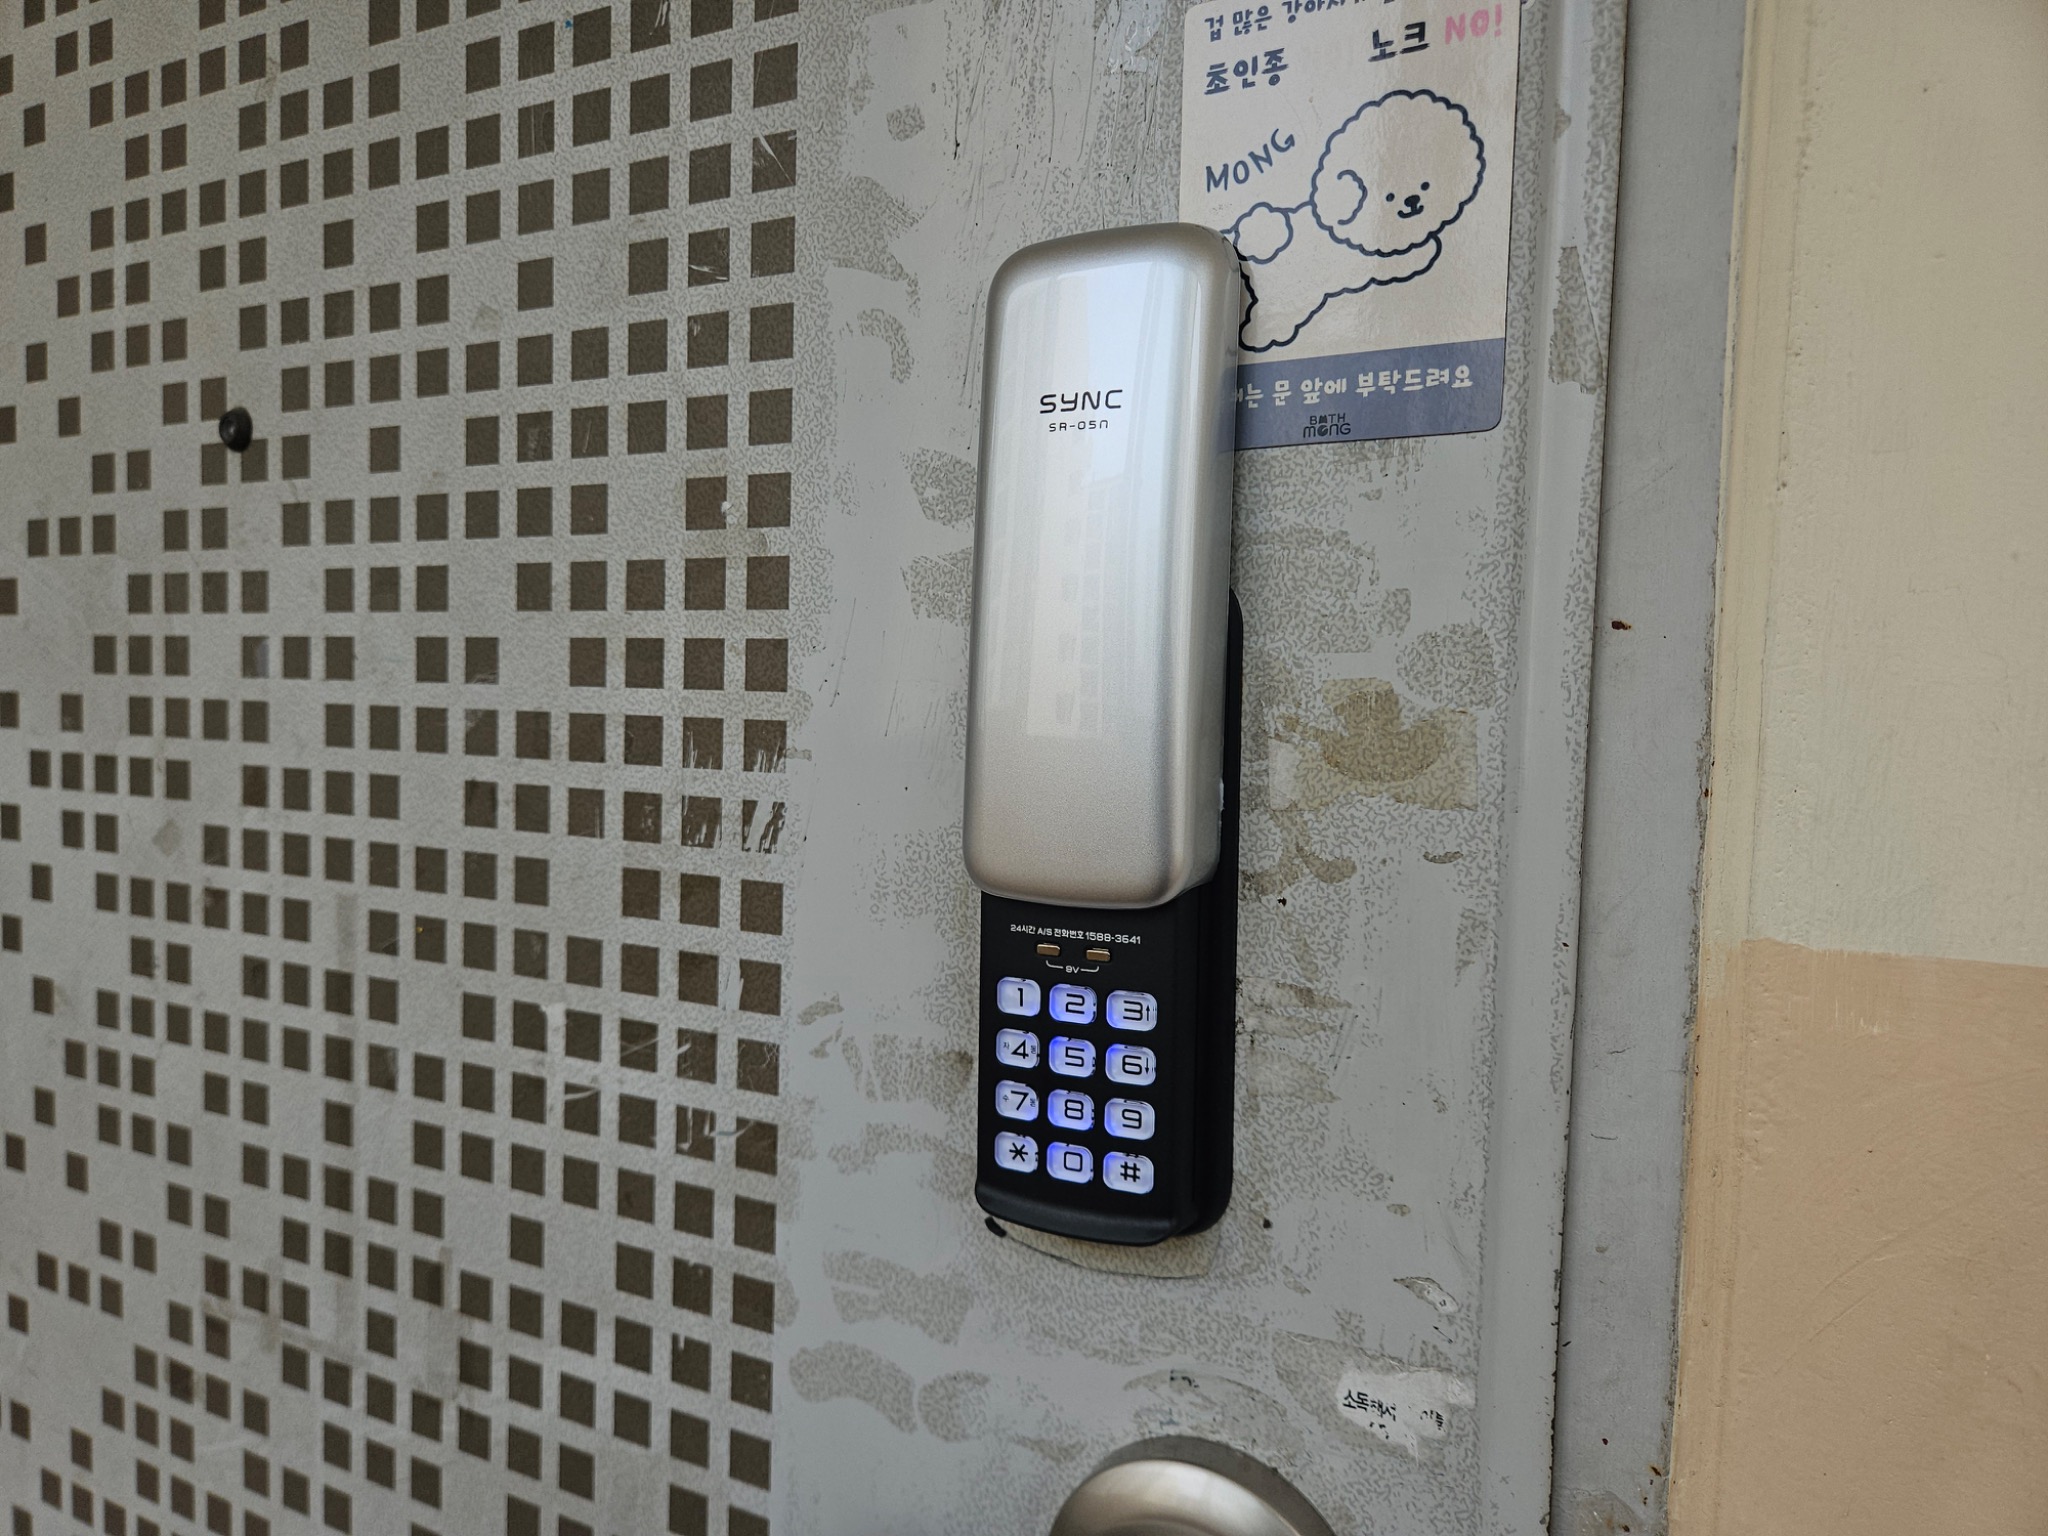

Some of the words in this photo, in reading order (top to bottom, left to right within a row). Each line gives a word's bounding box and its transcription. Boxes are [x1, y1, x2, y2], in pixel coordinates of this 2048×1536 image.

[1204, 14, 1224, 42] 겁
[1232, 5, 1273, 36] 많은
[1204, 47, 1289, 95] 초인종
[1368, 21, 1430, 62] 노크
[1444, 4, 1503, 45] NO!
[1205, 128, 1296, 193] MONG
[1237, 383, 1264, 409] 는
[1271, 379, 1293, 406] 문
[1300, 377, 1347, 404] 앞에
[1354, 364, 1474, 398] 부탁드려요
[1039, 389, 1123, 415] SYNC
[1010, 924, 1036, 935] 24시간
[1037, 927, 1053, 936] A/S
[1053, 928, 1085, 940] 전화번호
[1085, 931, 1141, 945] 1588-3641
[1017, 987, 1024, 1007] 1
[1065, 993, 1085, 1015] 2
[1123, 1000, 1143, 1021] 3
[1011, 1039, 1029, 1059] 4
[1065, 1046, 1085, 1067] 5
[1122, 1054, 1143, 1075] 6
[1010, 1089, 1029, 1111] 7
[1064, 1099, 1084, 1120] 8
[1122, 1108, 1142, 1129] 9
[1063, 1151, 1083, 1172] 0
[1120, 1161, 1141, 1182] #
